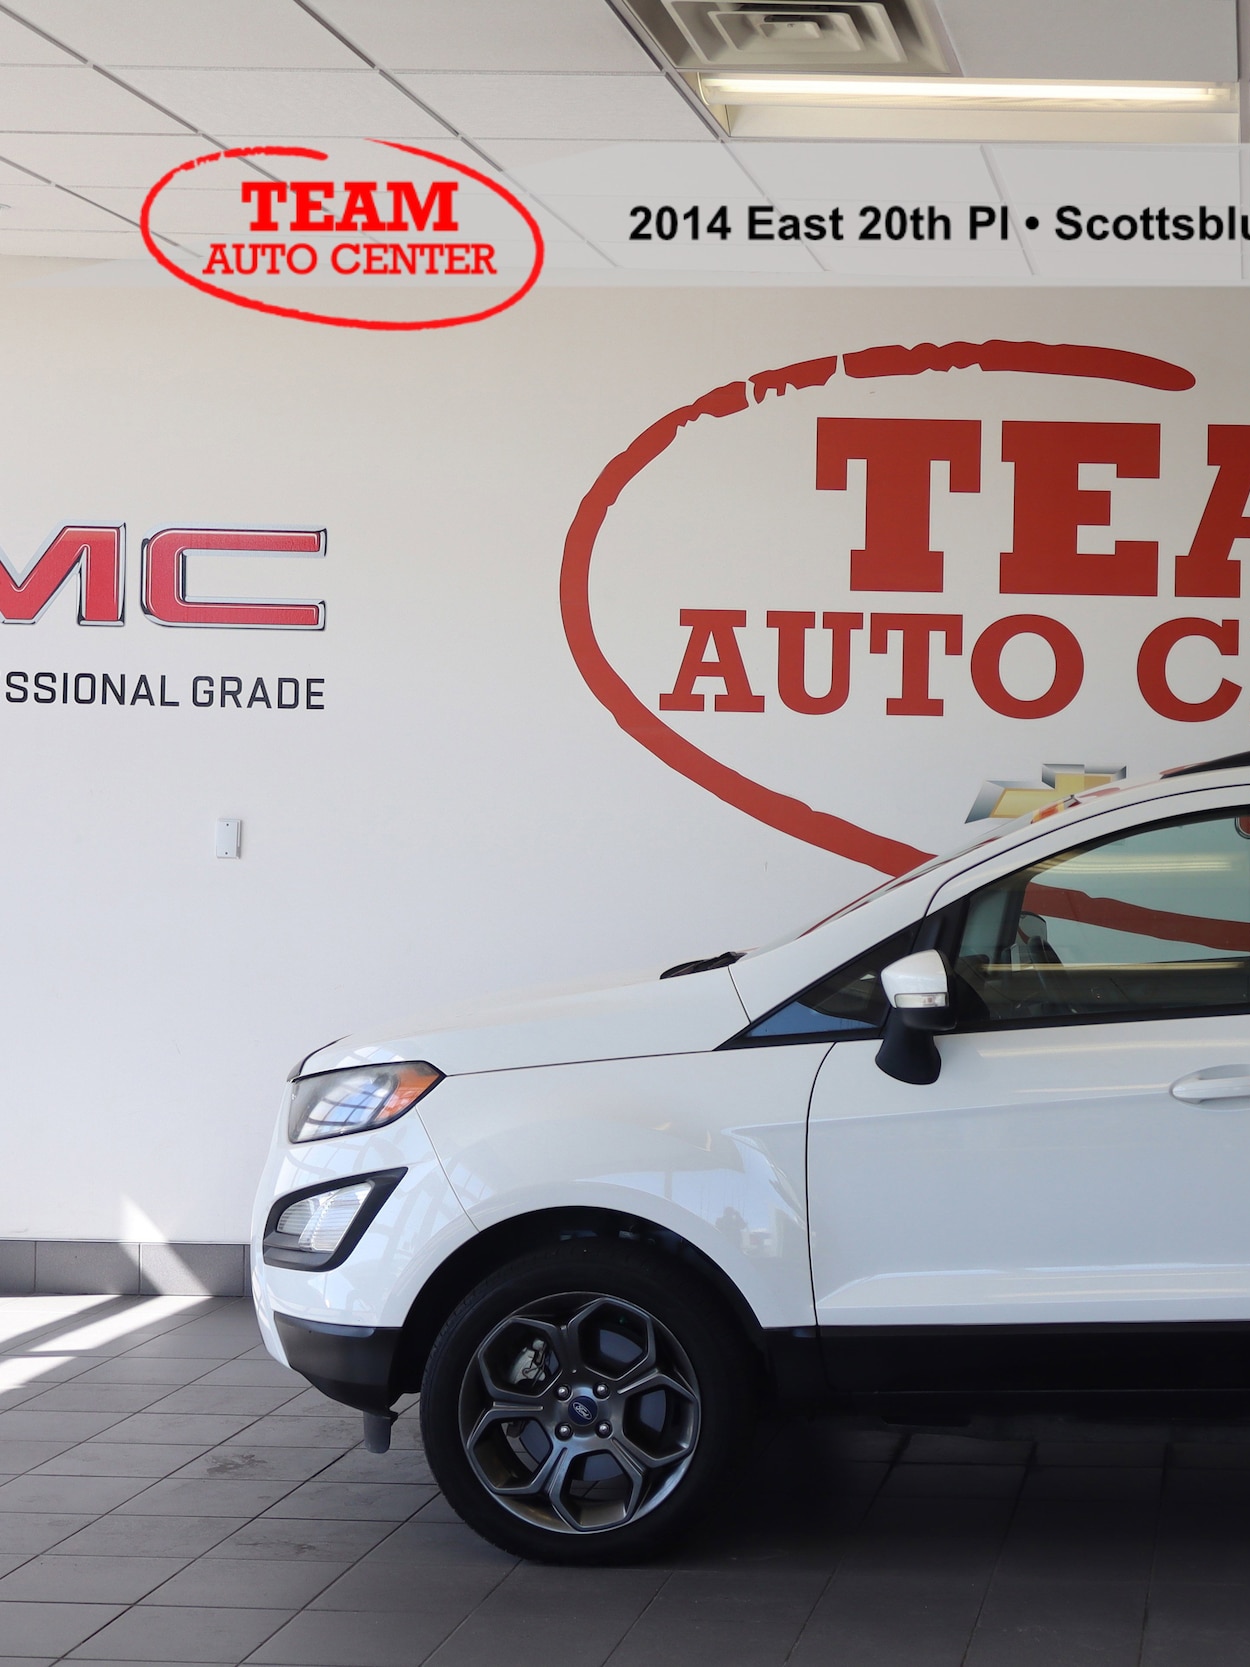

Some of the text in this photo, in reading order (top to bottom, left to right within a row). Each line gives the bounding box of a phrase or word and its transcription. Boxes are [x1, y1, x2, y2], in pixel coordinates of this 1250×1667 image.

[5, 671, 325, 710] SSIONAL GRADE
[659, 609, 1084, 720] AUTO
